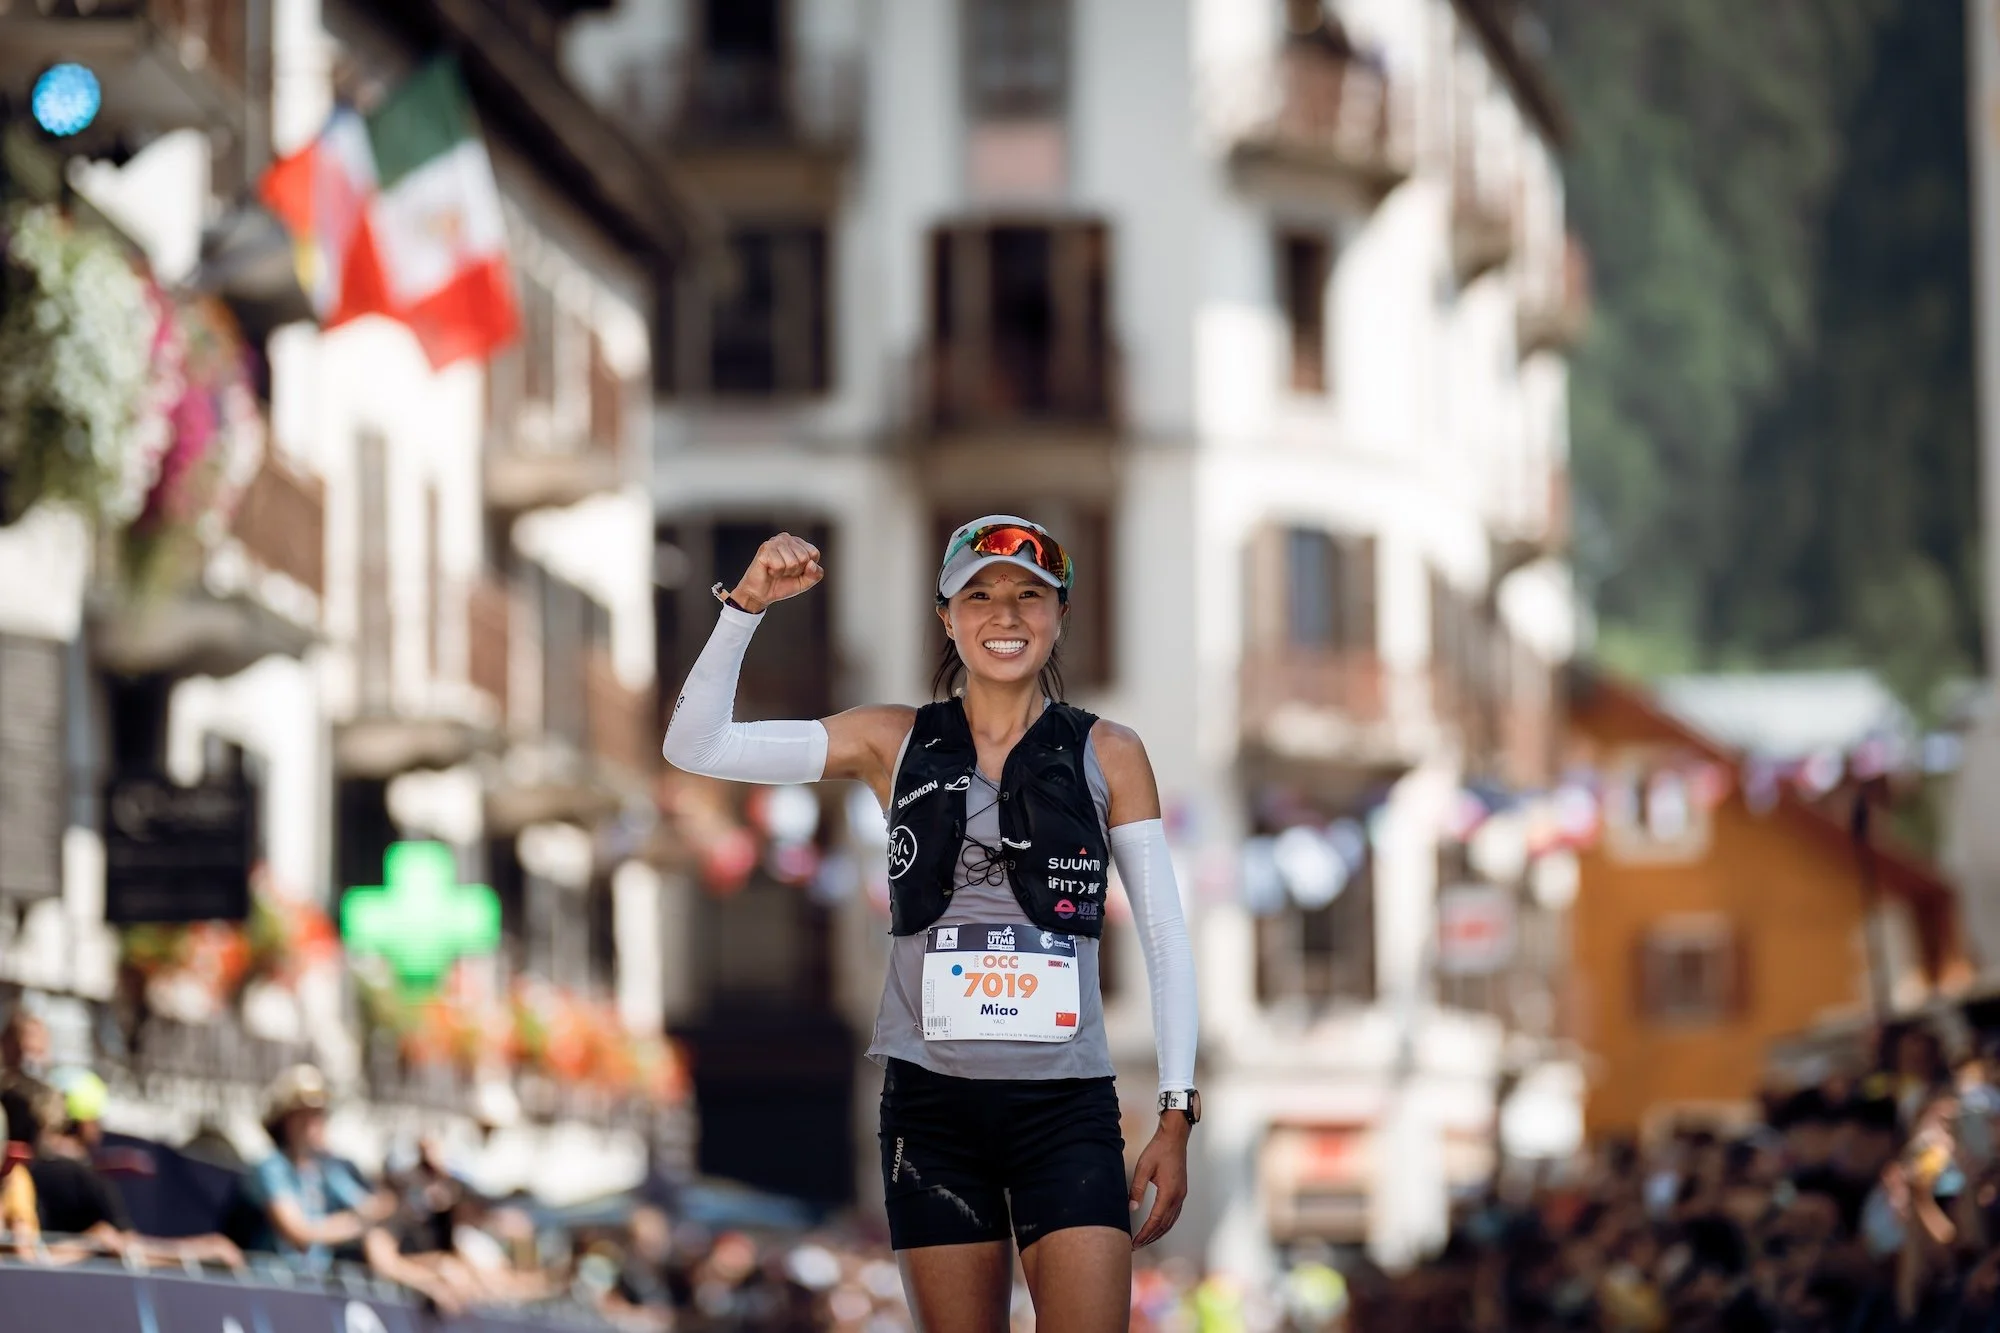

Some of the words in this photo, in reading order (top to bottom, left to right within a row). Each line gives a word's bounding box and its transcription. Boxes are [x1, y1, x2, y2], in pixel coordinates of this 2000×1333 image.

[898, 780, 938, 809] SALOMON
[1048, 876, 1077, 893] iFIT
[988, 936, 1015, 945] UTMB
[983, 955, 1019, 969] OCC
[963, 972, 1039, 999] 7019
[980, 1003, 1018, 1016] Miao
[892, 1136, 904, 1183] SALOMO
